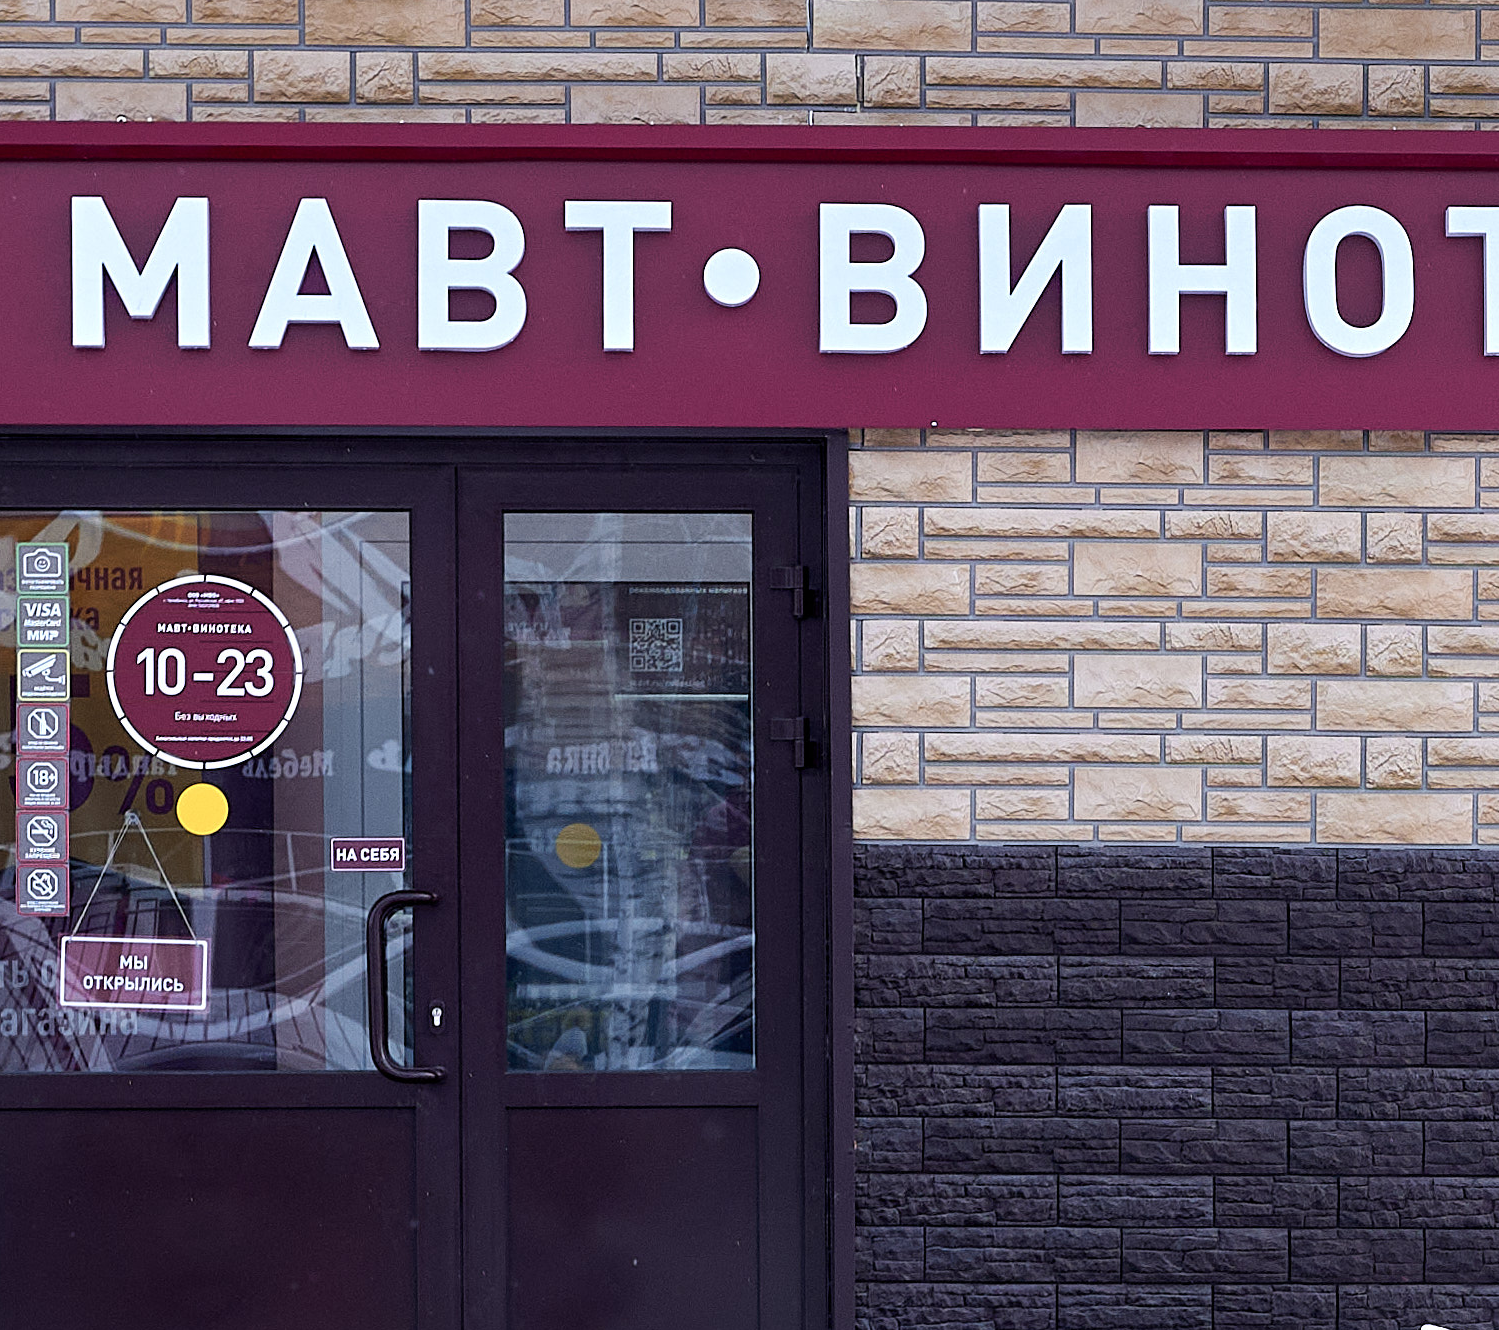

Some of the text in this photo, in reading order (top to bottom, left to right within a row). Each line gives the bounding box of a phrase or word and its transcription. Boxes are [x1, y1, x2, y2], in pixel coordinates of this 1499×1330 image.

[23, 603, 61, 617] VISA
[27, 630, 59, 641] МИР
[32, 769, 55, 786] 18+
[336, 848, 400, 862] НА СЕБЯ
[119, 955, 148, 970] МЫ
[83, 975, 185, 993] ОТКРЫЛИСЬ
